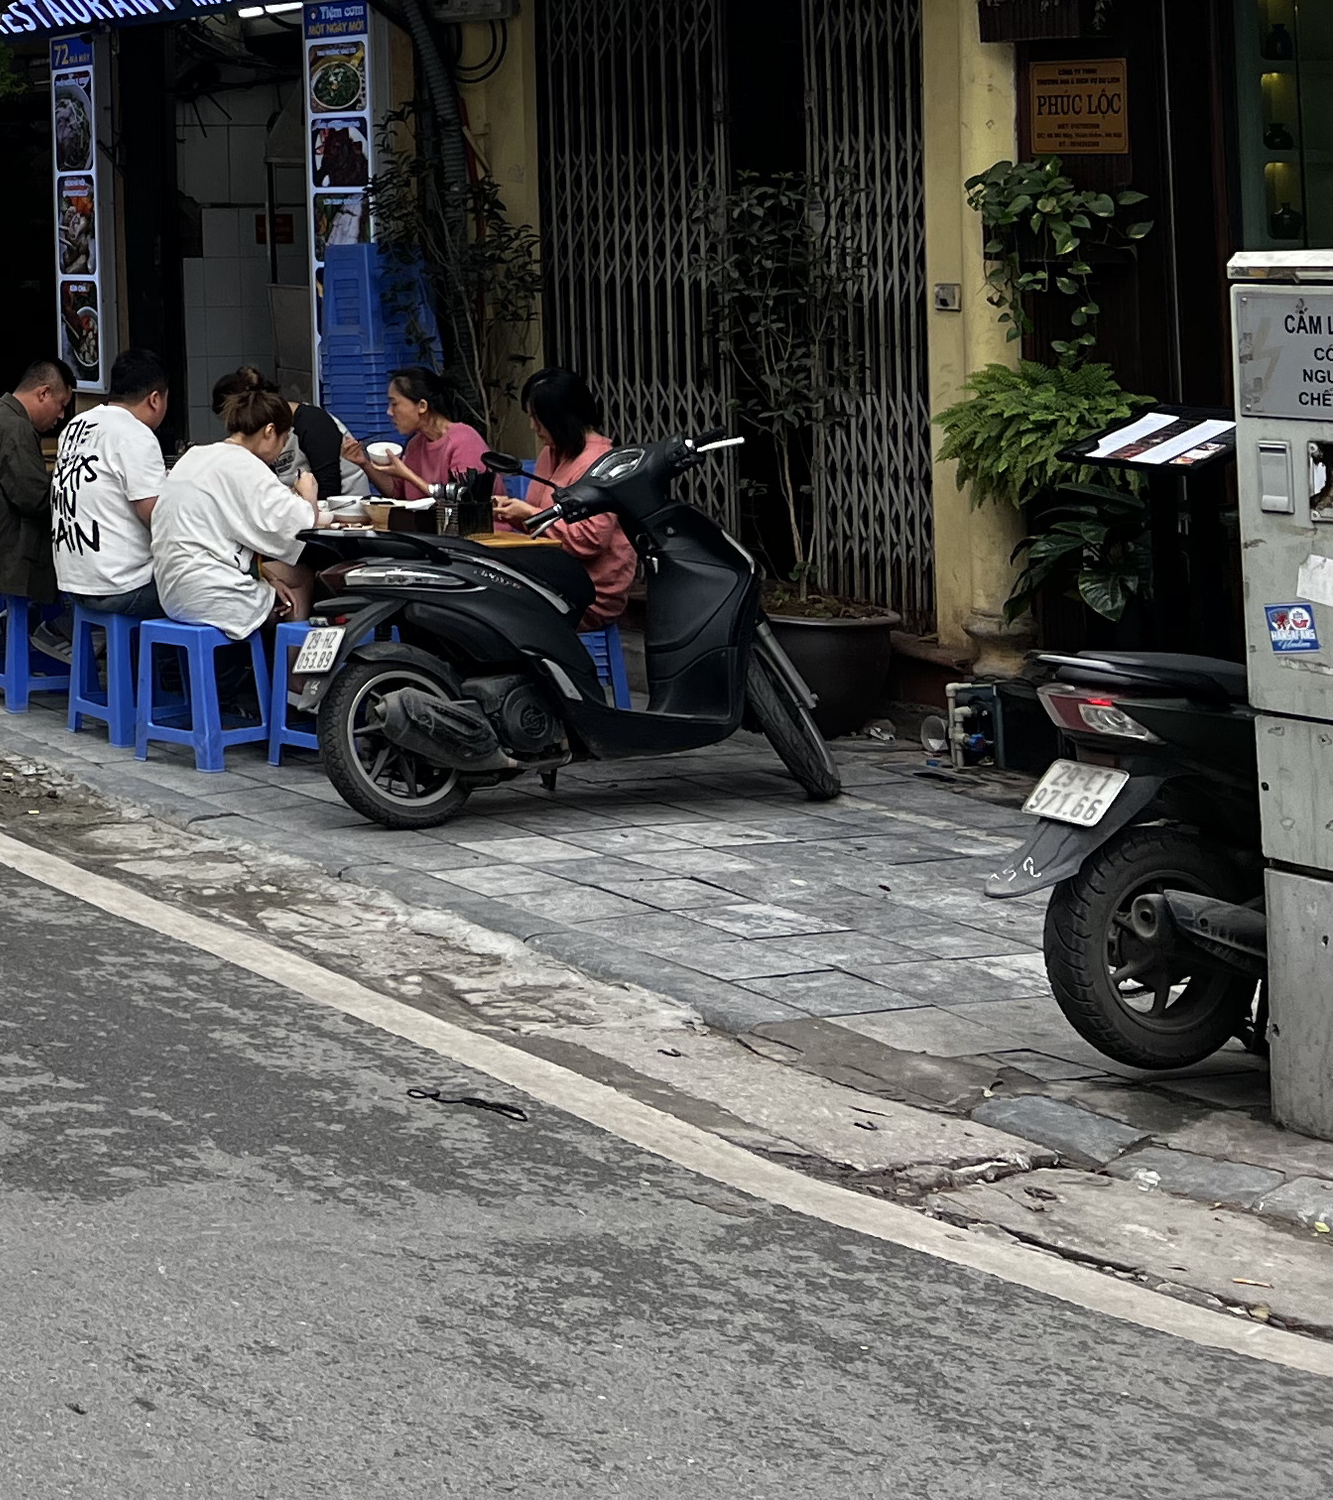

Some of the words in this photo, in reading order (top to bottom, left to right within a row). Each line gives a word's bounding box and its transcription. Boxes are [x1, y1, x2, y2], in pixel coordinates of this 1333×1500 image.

[53, 43, 69, 67] 72
[1036, 89, 1083, 116] PHÚC
[1087, 88, 1121, 120] LỘC
[1050, 764, 1114, 795] 29-C1
[1029, 787, 1103, 821] 971.66
